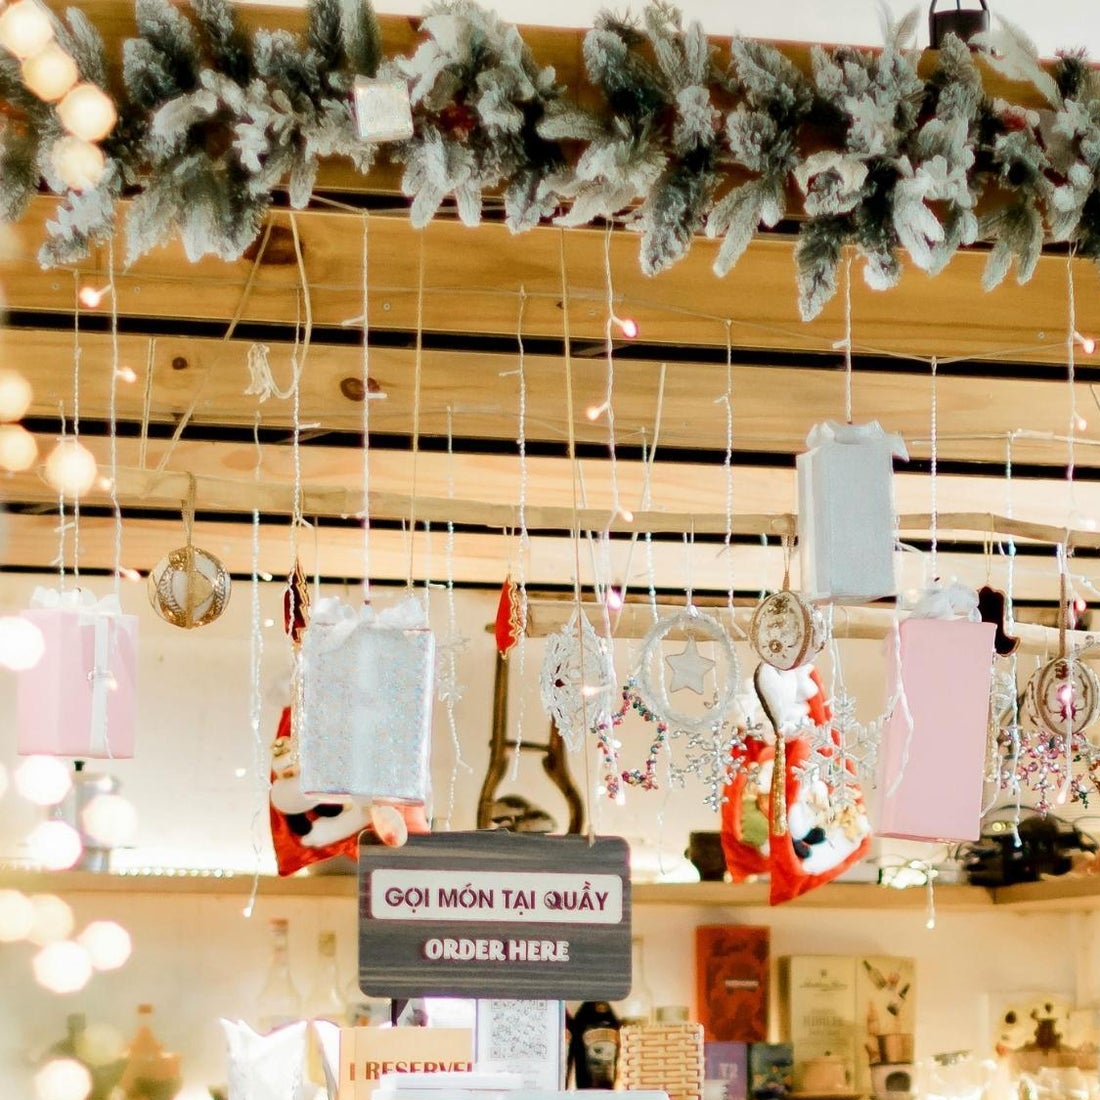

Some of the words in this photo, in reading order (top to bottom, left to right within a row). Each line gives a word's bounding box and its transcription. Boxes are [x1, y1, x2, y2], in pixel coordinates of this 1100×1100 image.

[384, 887, 430, 913] GỌI
[438, 883, 494, 909] MÓN
[502, 889, 536, 915] TẠI
[544, 881, 609, 911] QUẦY
[424, 938, 505, 961] ORDER
[509, 940, 570, 962] HERE
